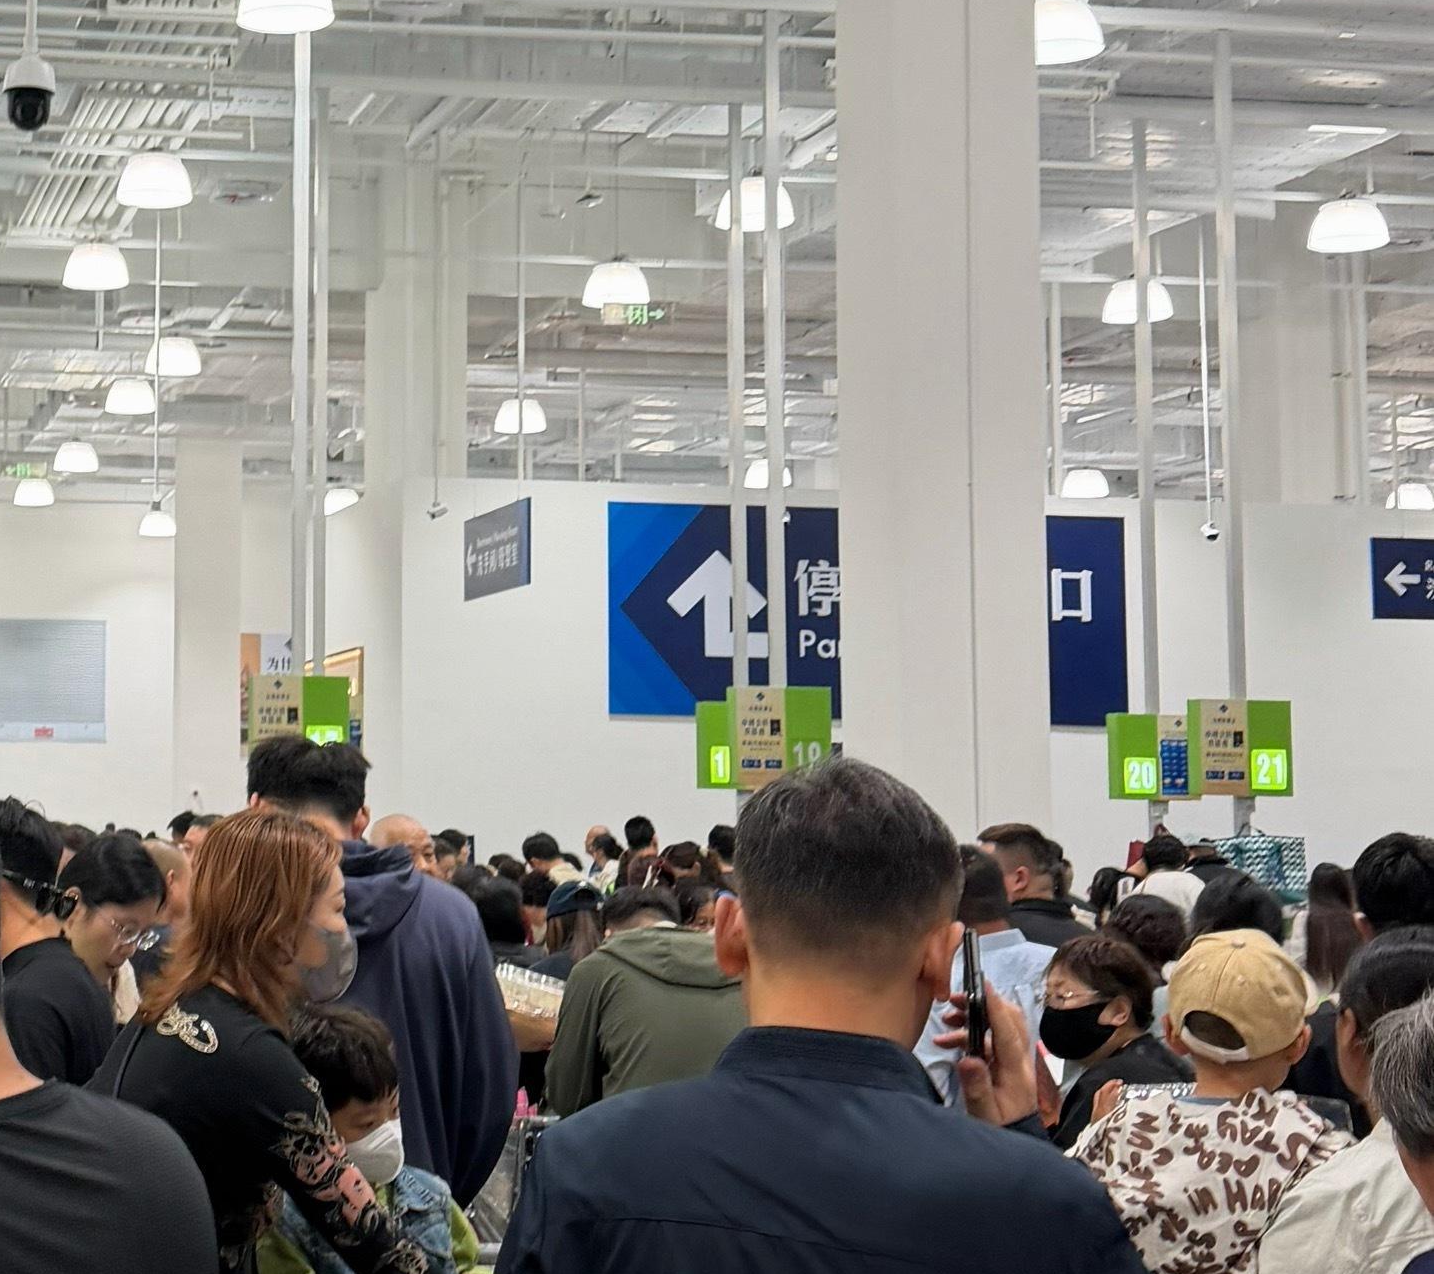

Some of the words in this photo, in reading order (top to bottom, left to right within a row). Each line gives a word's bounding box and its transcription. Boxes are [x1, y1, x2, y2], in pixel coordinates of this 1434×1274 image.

[1051, 568, 1093, 623] 口
[799, 629, 841, 659] Pa
[1128, 760, 1155, 790] 20
[1257, 752, 1282, 784] 21
